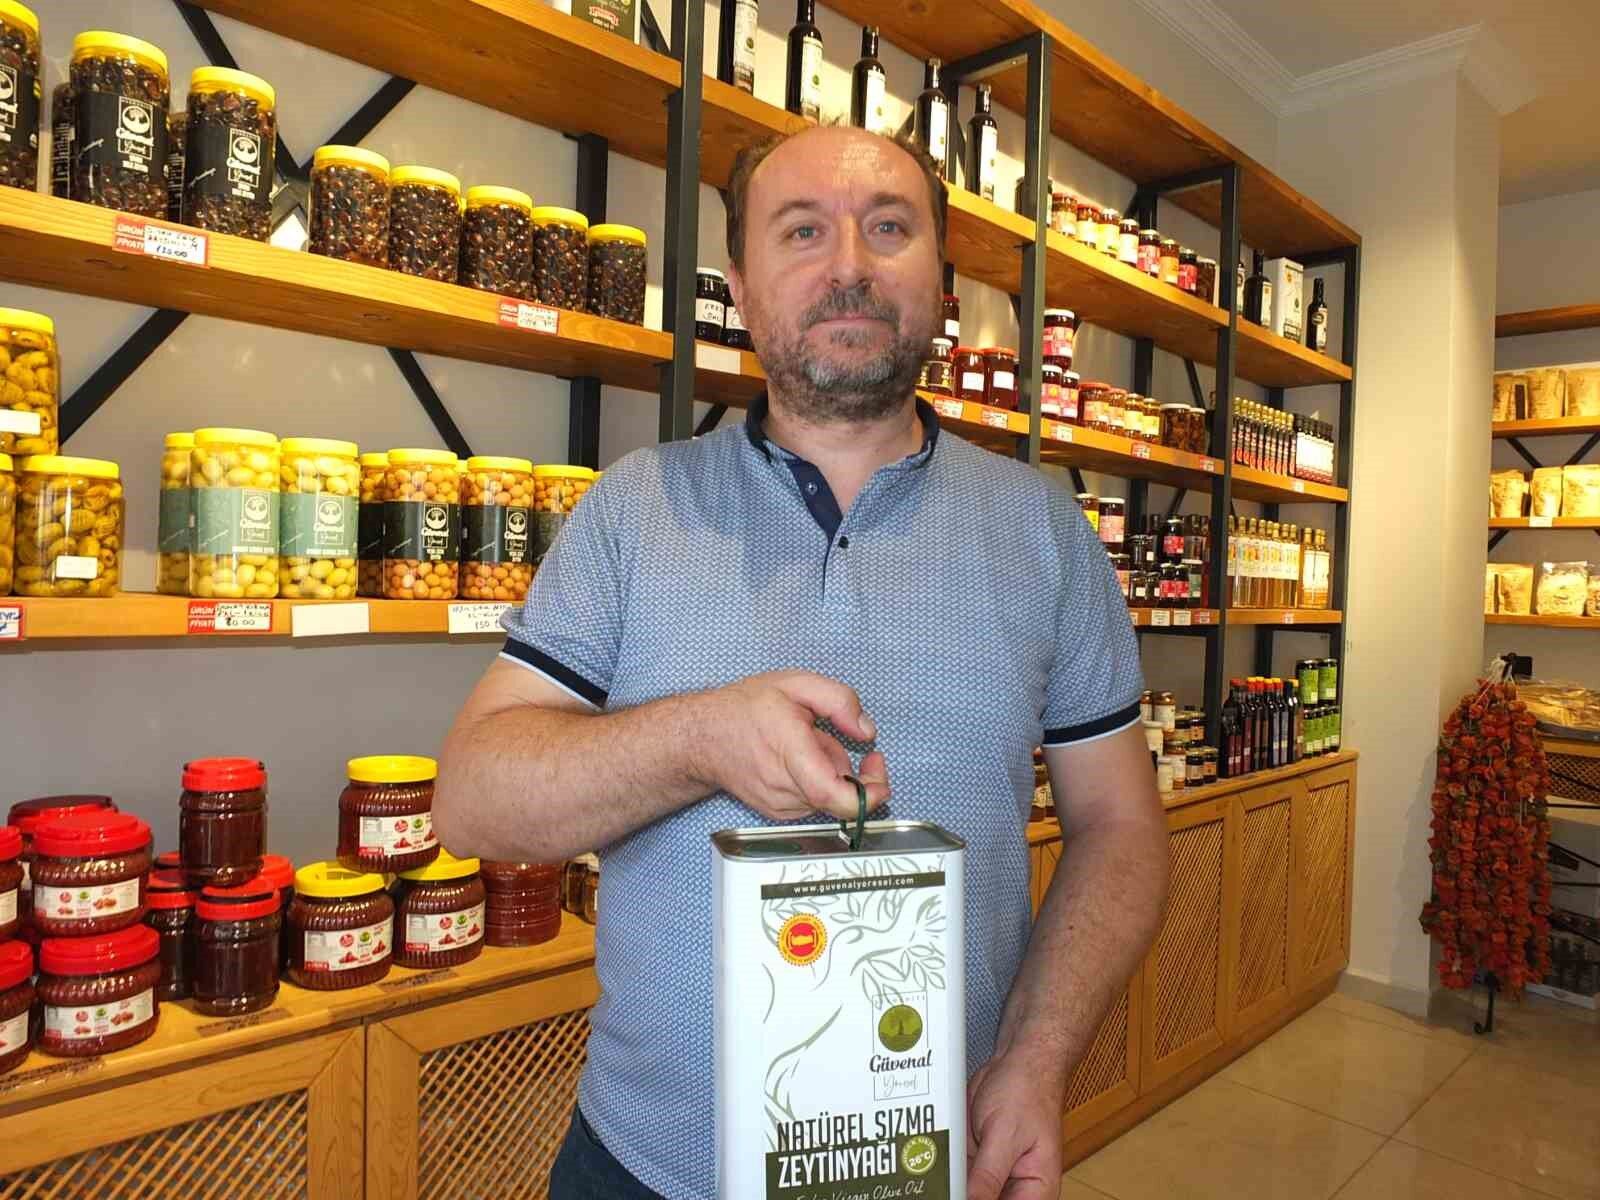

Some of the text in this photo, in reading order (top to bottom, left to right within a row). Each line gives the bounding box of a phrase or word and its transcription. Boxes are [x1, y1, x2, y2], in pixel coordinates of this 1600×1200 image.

[793, 876, 915, 894] www.guvenalyoresel.com
[869, 1048, 933, 1074] Güvenal
[776, 1111, 869, 1152] NATÜREL
[875, 1103, 935, 1139] SIZMA
[778, 1140, 897, 1189] ZEYTİNYAĞI
[904, 1179, 925, 1195] Oil
